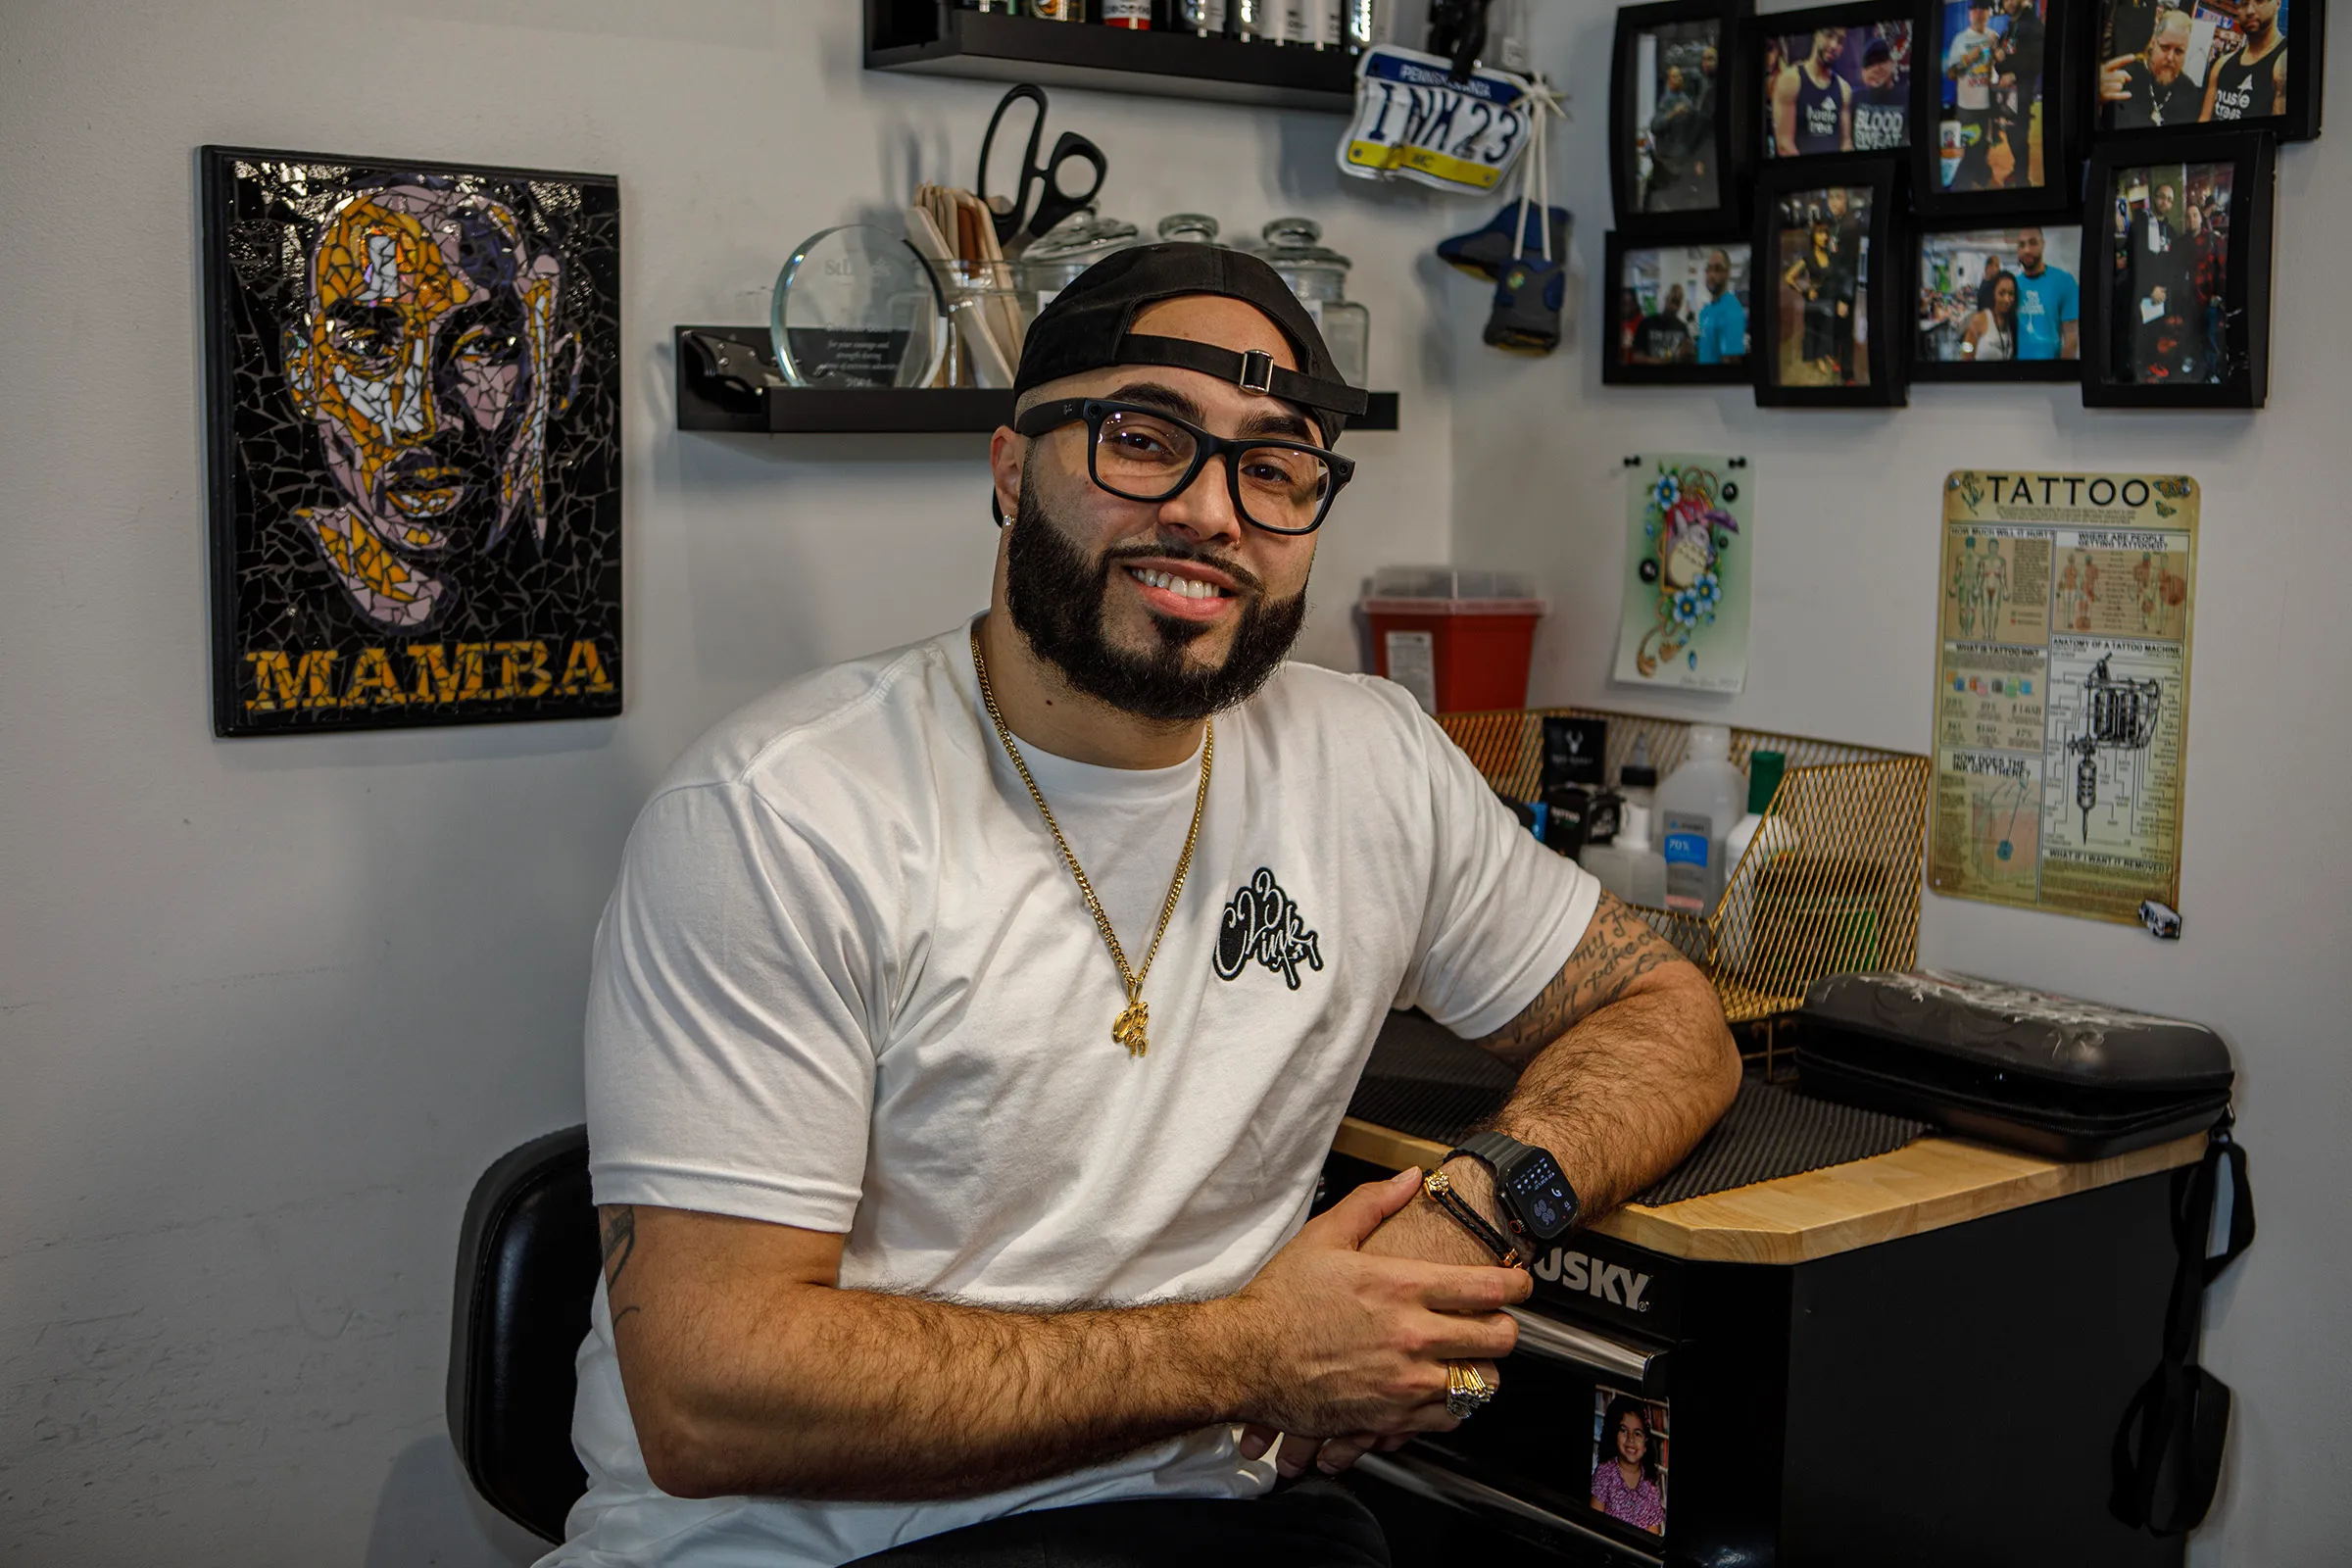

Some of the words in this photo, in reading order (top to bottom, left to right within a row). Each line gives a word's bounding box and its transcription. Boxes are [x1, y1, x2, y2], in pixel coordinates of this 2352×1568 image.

[1854, 108, 1904, 131] BLOOD
[1986, 475, 2150, 508] TATTOO
[2078, 531, 2108, 541] WHERE
[2112, 532, 2127, 541] ARE
[2131, 533, 2165, 543] PEOPLE
[1956, 643, 1979, 652] WHAT
[1988, 646, 2019, 656] TATTOO
[2053, 639, 2089, 648] ANATOMY
[2112, 643, 2142, 652] TATTOO
[2144, 645, 2179, 654] MACHINE
[245, 640, 614, 710] MAMBA
[1953, 752, 1976, 762] HOW
[2009, 758, 2026, 768] THE
[1971, 763, 1989, 775] GET
[2050, 849, 2073, 859] WHAT
[2088, 853, 2112, 864] WANT
[1571, 932, 1615, 966] my
[1534, 1247, 1649, 1311] USKY
